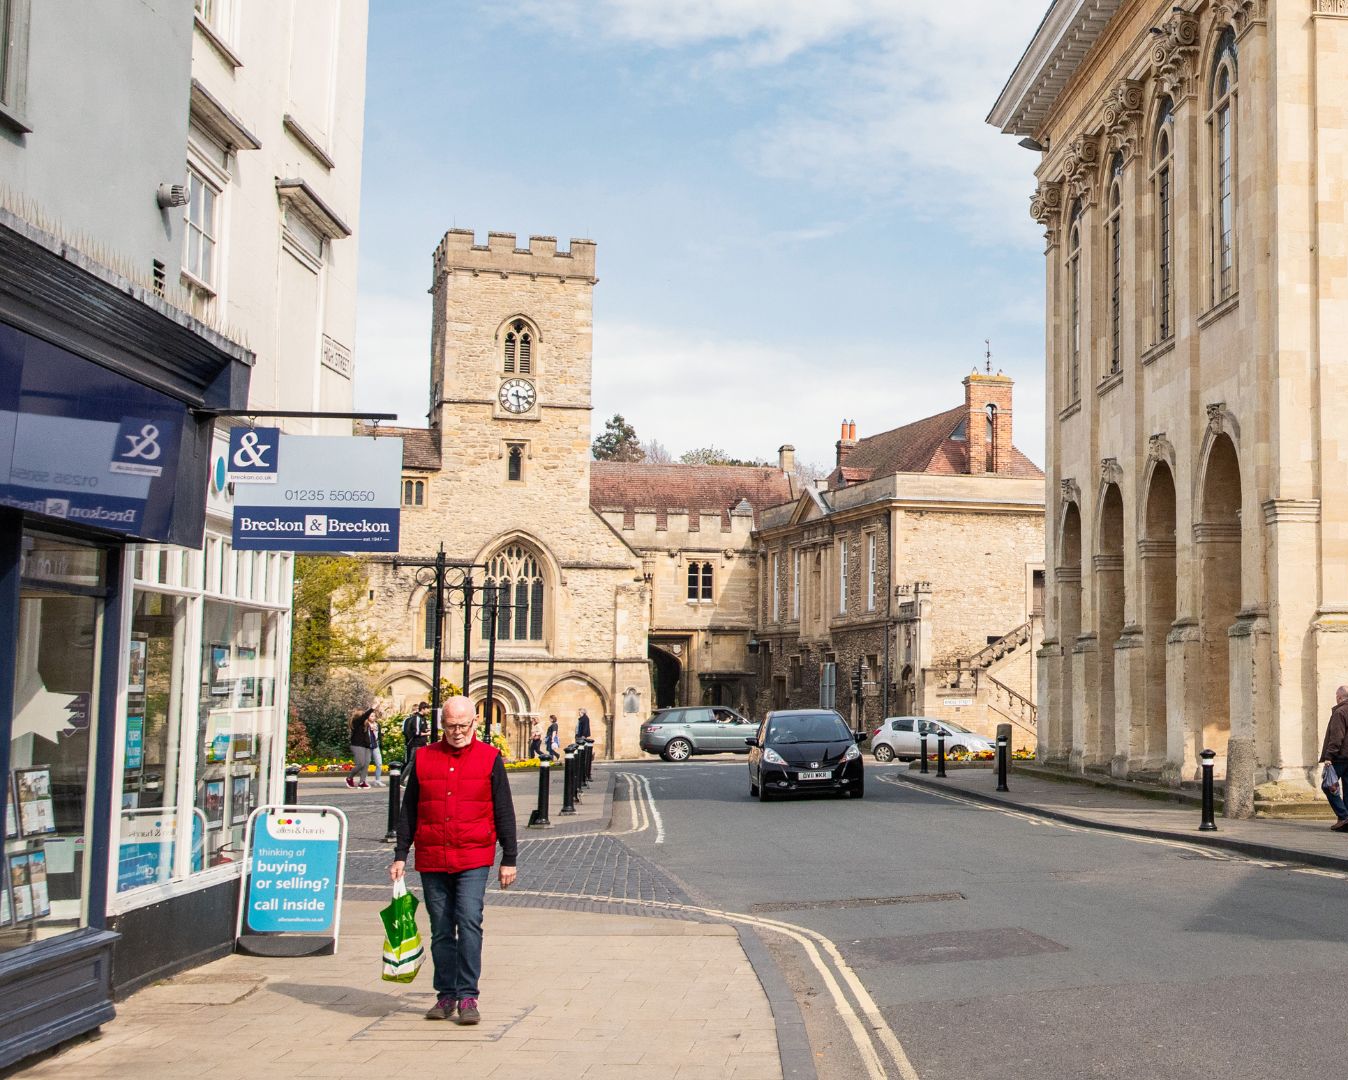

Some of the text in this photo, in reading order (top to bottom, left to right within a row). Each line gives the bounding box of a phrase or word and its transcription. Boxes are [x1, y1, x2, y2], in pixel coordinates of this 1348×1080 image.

[323, 343, 333, 364] HIGH
[335, 352, 350, 372] STREET
[233, 432, 271, 467] &
[285, 489, 375, 501] 01235 550550
[240, 517, 390, 533] Breckon & Breckon
[259, 848, 306, 859] thinking of
[257, 860, 307, 875] buying
[256, 877, 330, 892] or selling?
[254, 898, 326, 911] call inside
